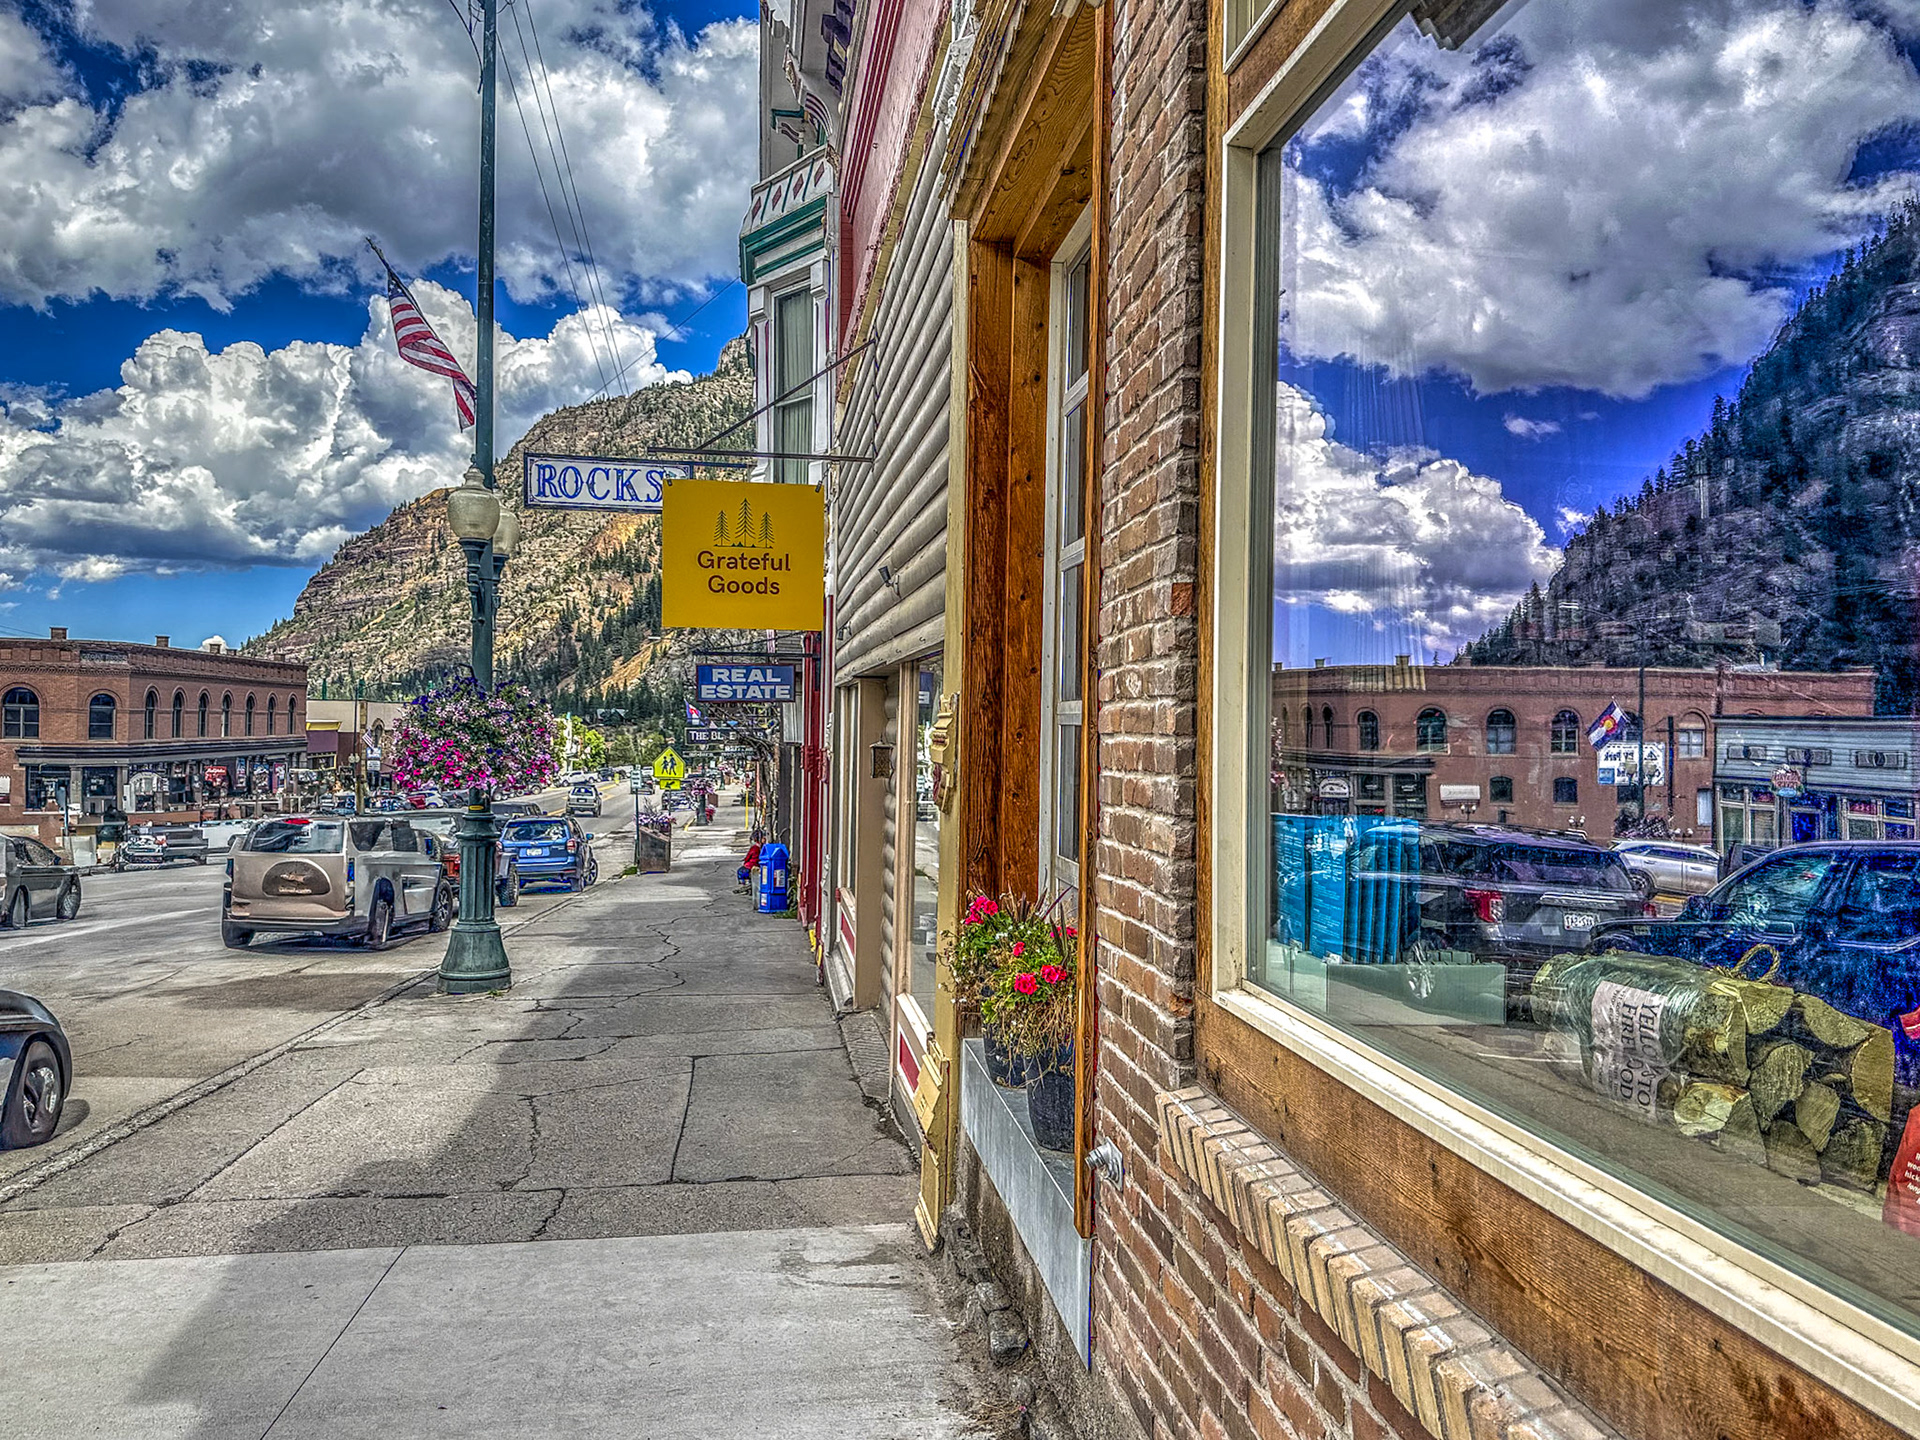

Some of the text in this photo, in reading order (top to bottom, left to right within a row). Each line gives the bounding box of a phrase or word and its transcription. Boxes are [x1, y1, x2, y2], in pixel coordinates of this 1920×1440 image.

[535, 463, 663, 503] ROCKS
[697, 550, 791, 571] Grateful
[707, 574, 781, 595] Goods
[712, 668, 782, 682] REAL
[701, 684, 791, 699] ESTATE
[689, 731, 709, 741] THE
[711, 731, 736, 741] BLE
